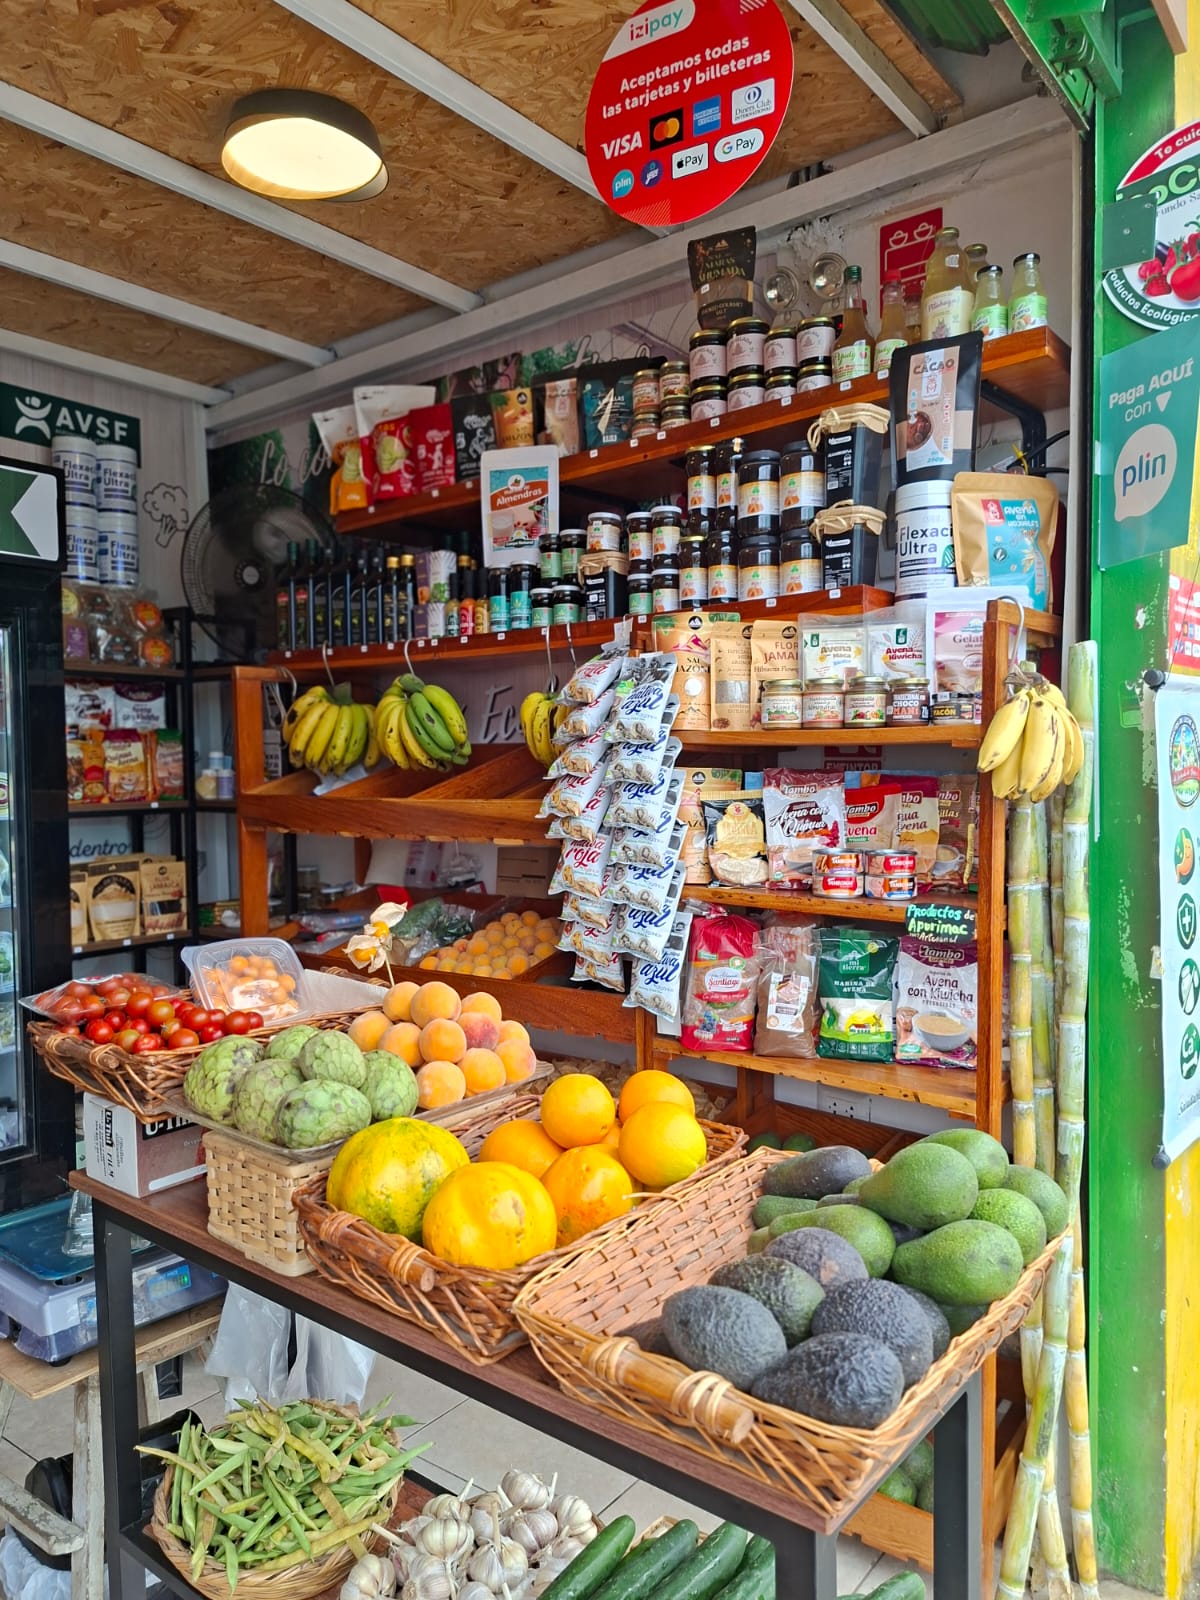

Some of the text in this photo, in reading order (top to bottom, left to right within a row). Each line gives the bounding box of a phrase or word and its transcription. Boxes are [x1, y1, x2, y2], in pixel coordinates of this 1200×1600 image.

[629, 8, 683, 41] izipay
[619, 36, 750, 94] Aceptamos todas
[602, 50, 771, 119] las tarjetas y billeteras
[600, 131, 643, 160] VISA
[736, 137, 756, 152] Pay
[684, 153, 704, 167] Pay
[1156, 198, 1187, 216] undo
[1109, 270, 1141, 310] roductos
[1107, 357, 1195, 410] Paga AQUÍ
[1124, 400, 1152, 423] con
[55, 406, 128, 442] AVSF
[1122, 452, 1167, 497] plin
[496, 487, 543, 507] Almendras
[899, 541, 938, 557] Ultra
[774, 641, 798, 650] FLOR
[821, 646, 852, 654] Avena
[885, 647, 914, 655] Avena
[620, 693, 664, 715] azul
[623, 776, 665, 799] azul
[783, 784, 816, 794] Tambo
[848, 826, 877, 836] vena
[70, 838, 128, 858] dentro
[565, 847, 602, 868] roja
[628, 906, 672, 929] azul
[907, 904, 975, 920] Productos de
[907, 918, 968, 935] Apurimac
[922, 946, 961, 959] Tambo
[640, 960, 680, 985] azul
[923, 975, 959, 988] Avena
[907, 987, 974, 1003] con Kiwicha
